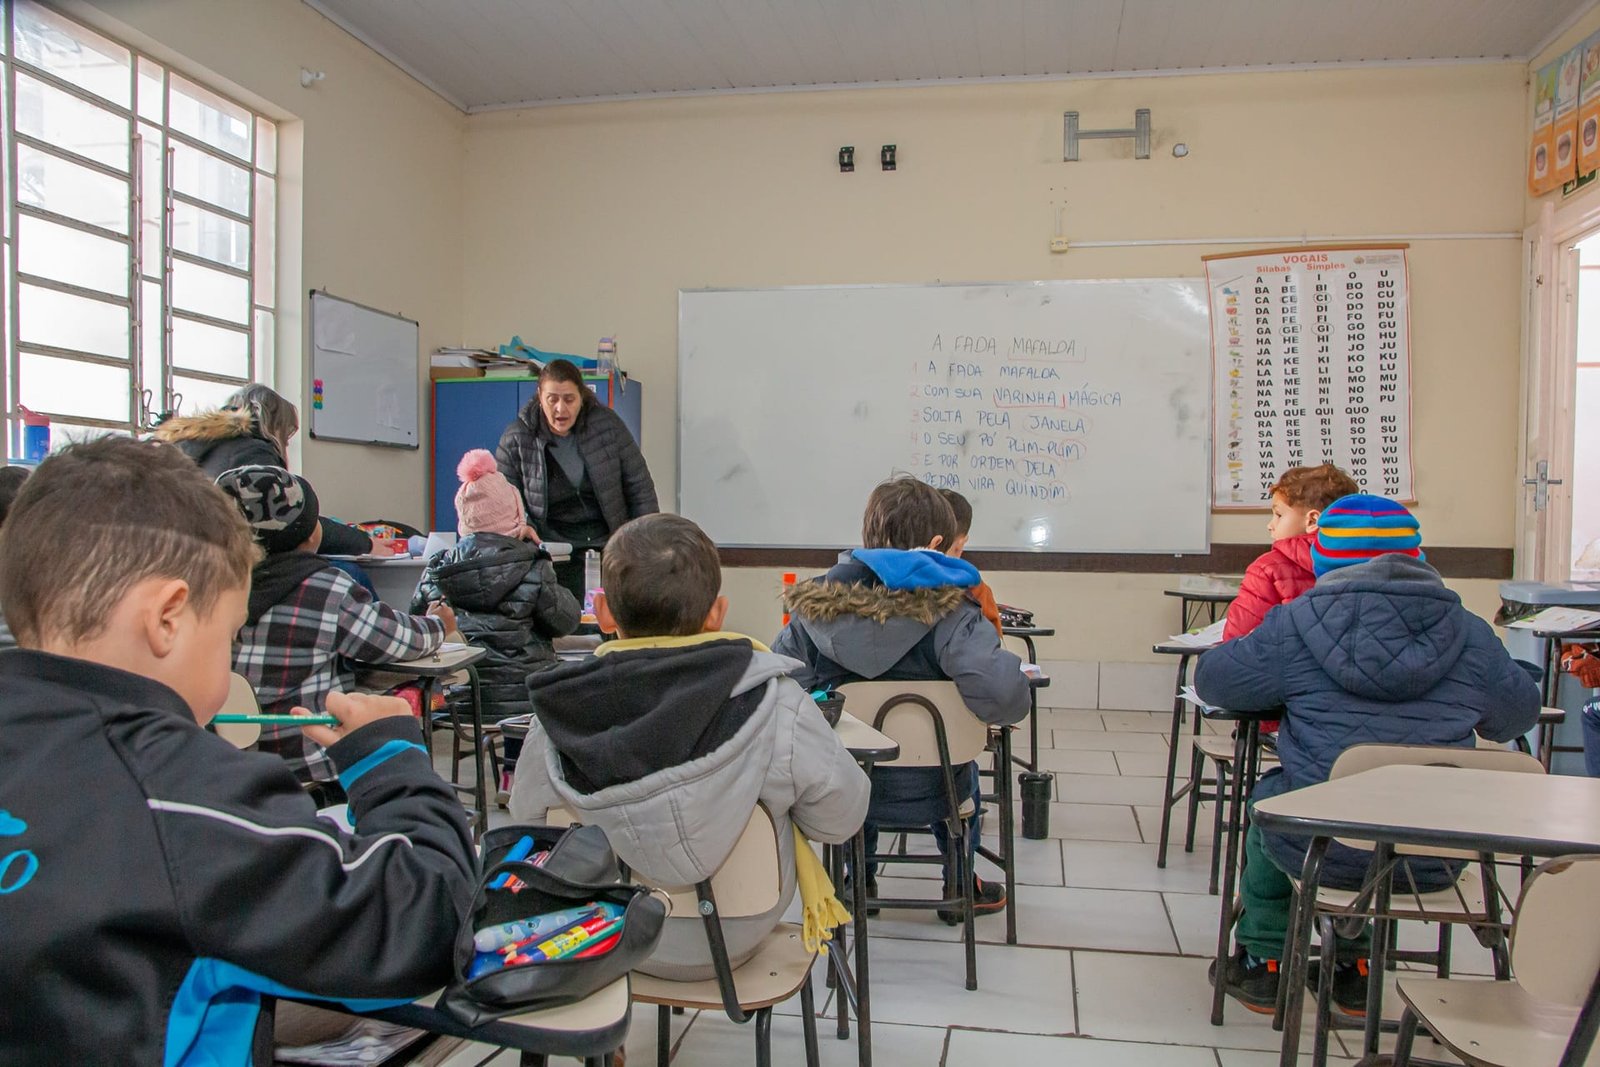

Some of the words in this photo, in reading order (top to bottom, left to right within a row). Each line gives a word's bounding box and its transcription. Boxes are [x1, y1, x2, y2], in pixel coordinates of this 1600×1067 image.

[1283, 255, 1328, 264] VOGAIS
[1306, 263, 1345, 271] Simples
[1347, 282, 1363, 290] BO
[1282, 306, 1296, 314] DE
[1378, 301, 1394, 309] DU
[1283, 326, 1299, 334] GE
[1379, 321, 1395, 329] GU
[1348, 333, 1365, 341] HO
[932, 334, 941, 351] A
[955, 336, 996, 355] FADA
[1013, 337, 1076, 356] MAFALDA
[1284, 357, 1299, 365] KE
[1380, 363, 1395, 371] LU
[928, 361, 936, 373] A
[949, 363, 983, 377] FADA
[1000, 367, 1060, 380] MAFALDA
[924, 384, 950, 398] COM
[954, 387, 982, 400] SUA
[995, 388, 1056, 404] VARINHA
[1069, 382, 1122, 407] MÁGICA
[1254, 410, 1276, 418] QUA
[923, 409, 962, 424] SOLTA
[977, 411, 1010, 429] PELA
[1029, 416, 1085, 434] JANELA
[924, 433, 931, 445] O
[938, 432, 966, 446] SEU
[924, 454, 932, 466] E
[939, 454, 958, 469] POR
[971, 456, 1015, 471] ORDEM
[1025, 460, 1056, 478] DELA
[923, 471, 960, 488] PEDRA
